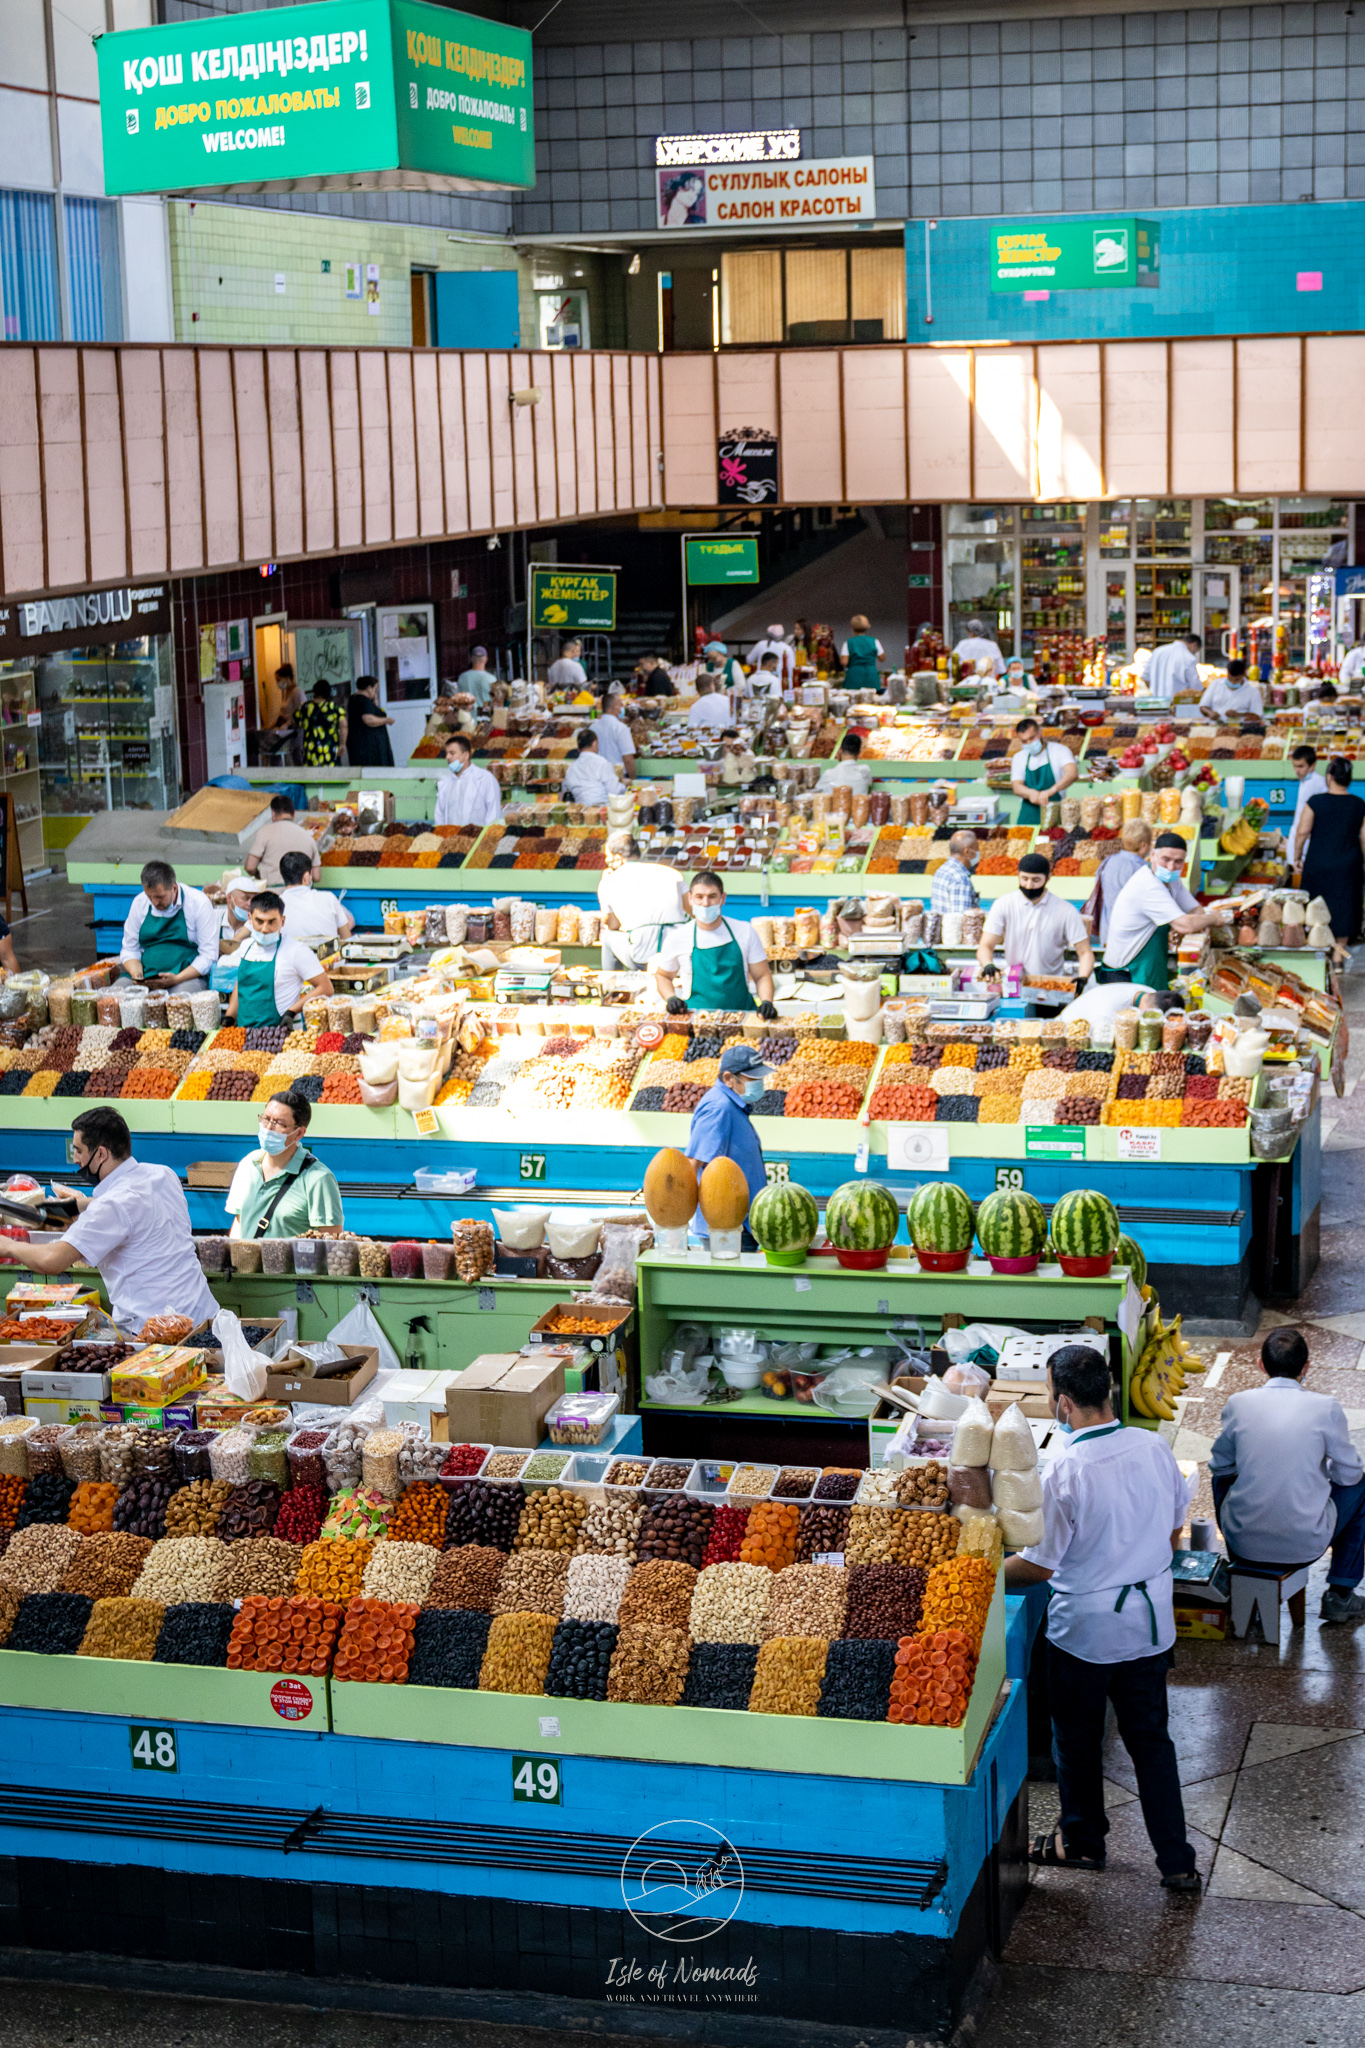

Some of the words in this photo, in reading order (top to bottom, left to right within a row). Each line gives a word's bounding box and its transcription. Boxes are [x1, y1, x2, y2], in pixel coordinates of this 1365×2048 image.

[406, 29, 442, 68] ҚОШ
[123, 54, 183, 94] ҚОШ
[191, 29, 368, 82] КЕЛДІҢІЗДЕР!
[155, 101, 211, 130] ДОБРО
[215, 87, 340, 120] ПОЖАЛОВАТЬ!
[426, 87, 457, 112] ДОБРО
[458, 94, 515, 125] ПОЖАЛОВАТЬ!
[202, 125, 286, 153] WELCOME!
[452, 125, 492, 149] WELCOME!
[708, 171, 791, 192] СҰЛУЛЫҚ
[794, 166, 868, 187] САЛОНЫ
[717, 201, 774, 220] САЛОН
[780, 196, 861, 219] КРАСОТЫ
[541, 588, 609, 601] ЖЕМІСТЕР
[1270, 789, 1285, 802] 83
[381, 900, 398, 917] 66
[520, 1155, 545, 1178] 57
[764, 1162, 789, 1187] 58
[996, 1168, 1022, 1190] 59
[133, 1730, 175, 1768] 48
[514, 1761, 558, 1800] 49
